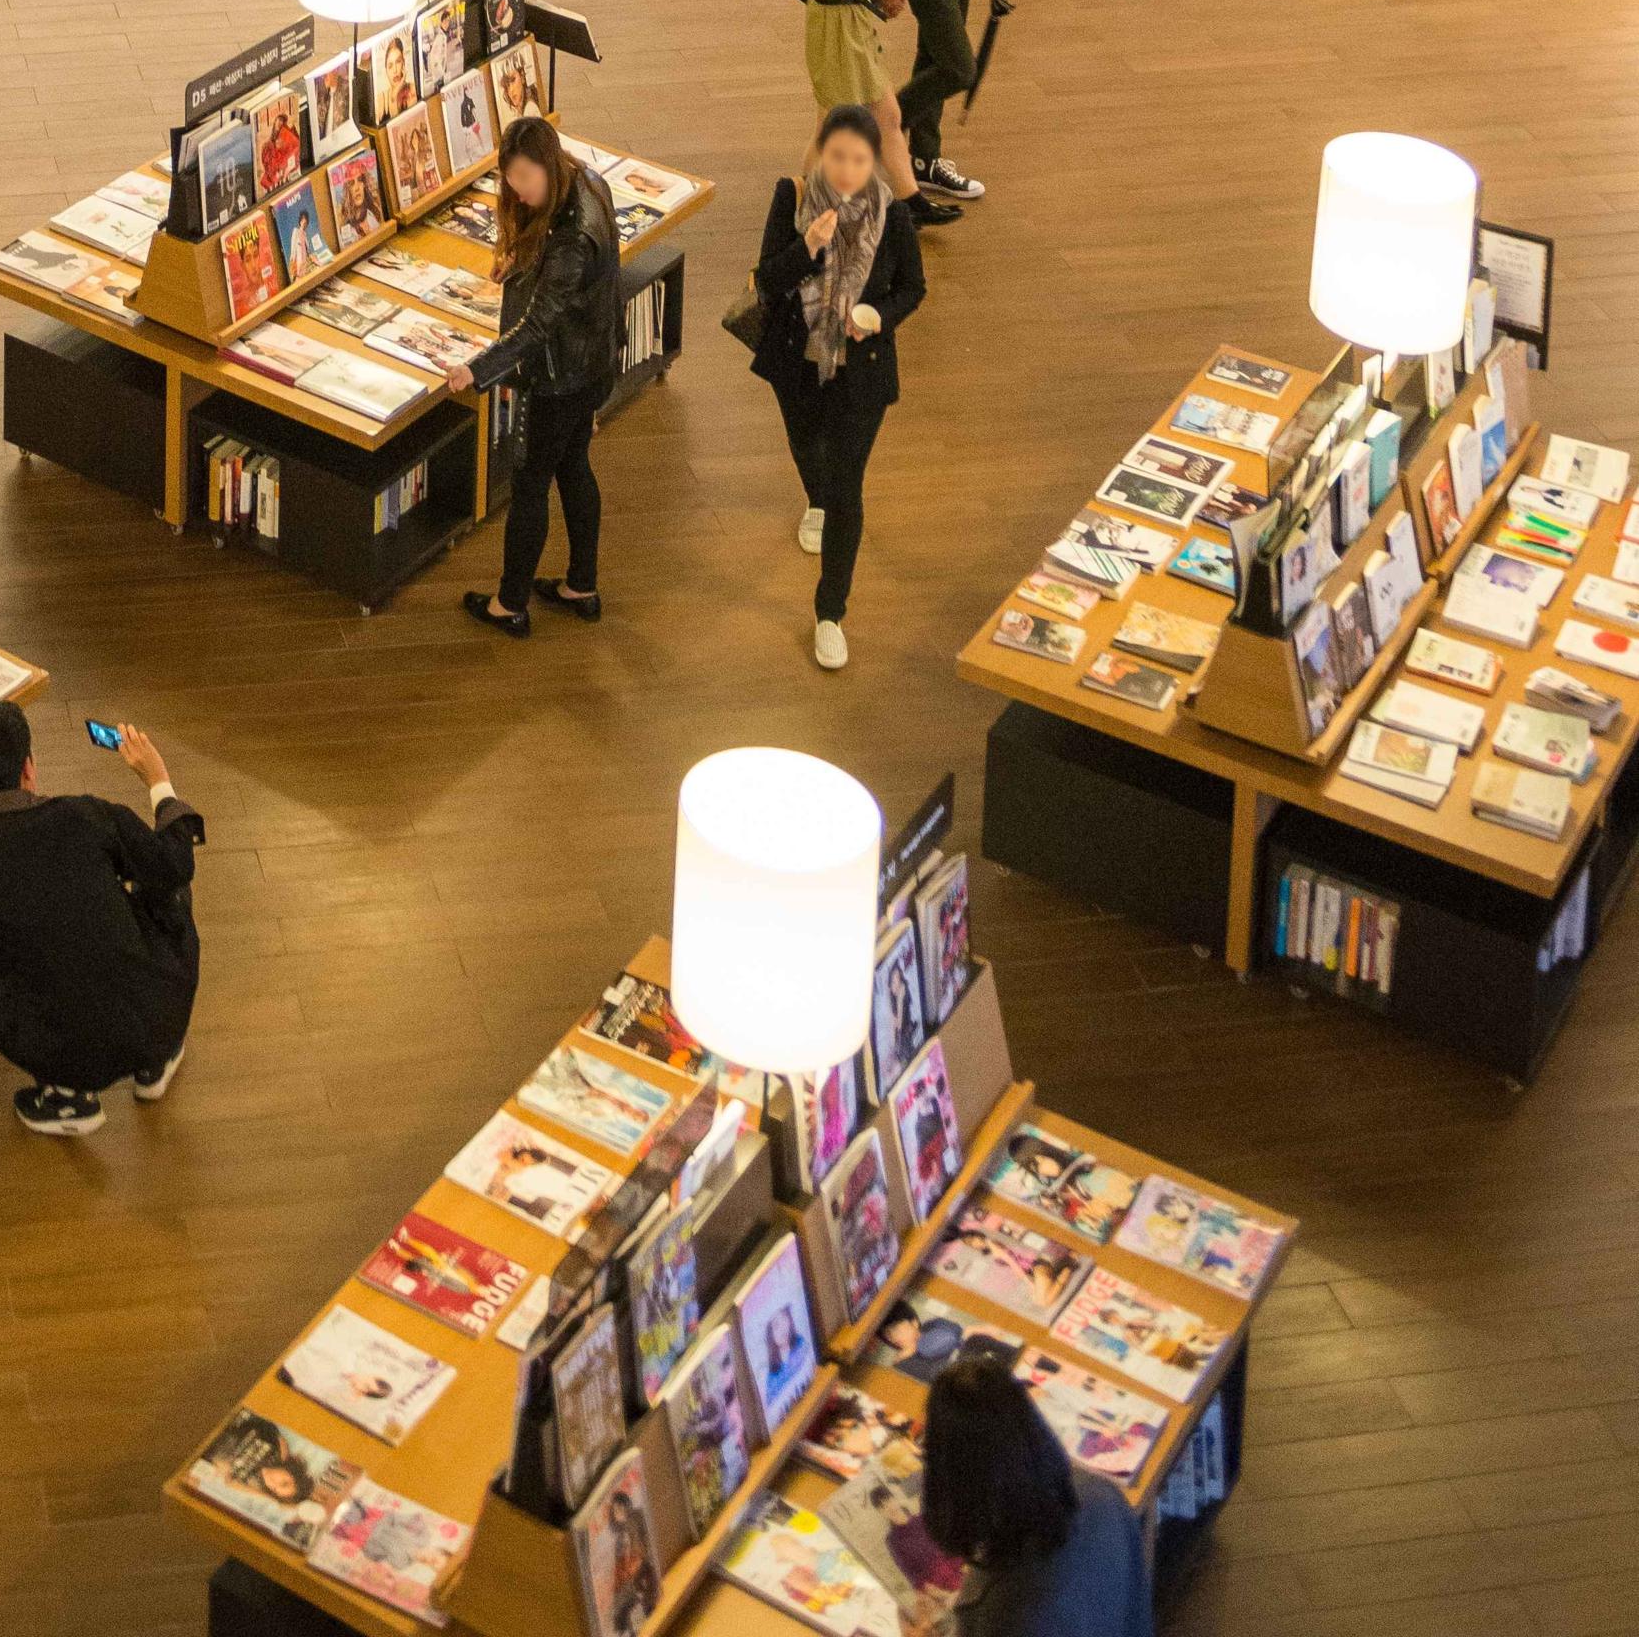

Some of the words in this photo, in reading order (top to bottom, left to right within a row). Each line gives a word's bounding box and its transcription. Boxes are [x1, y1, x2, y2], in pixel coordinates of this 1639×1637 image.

[192, 88, 207, 108] D5
[460, 1260, 528, 1334] FUDGE
[1055, 1269, 1119, 1340] FUDGE
